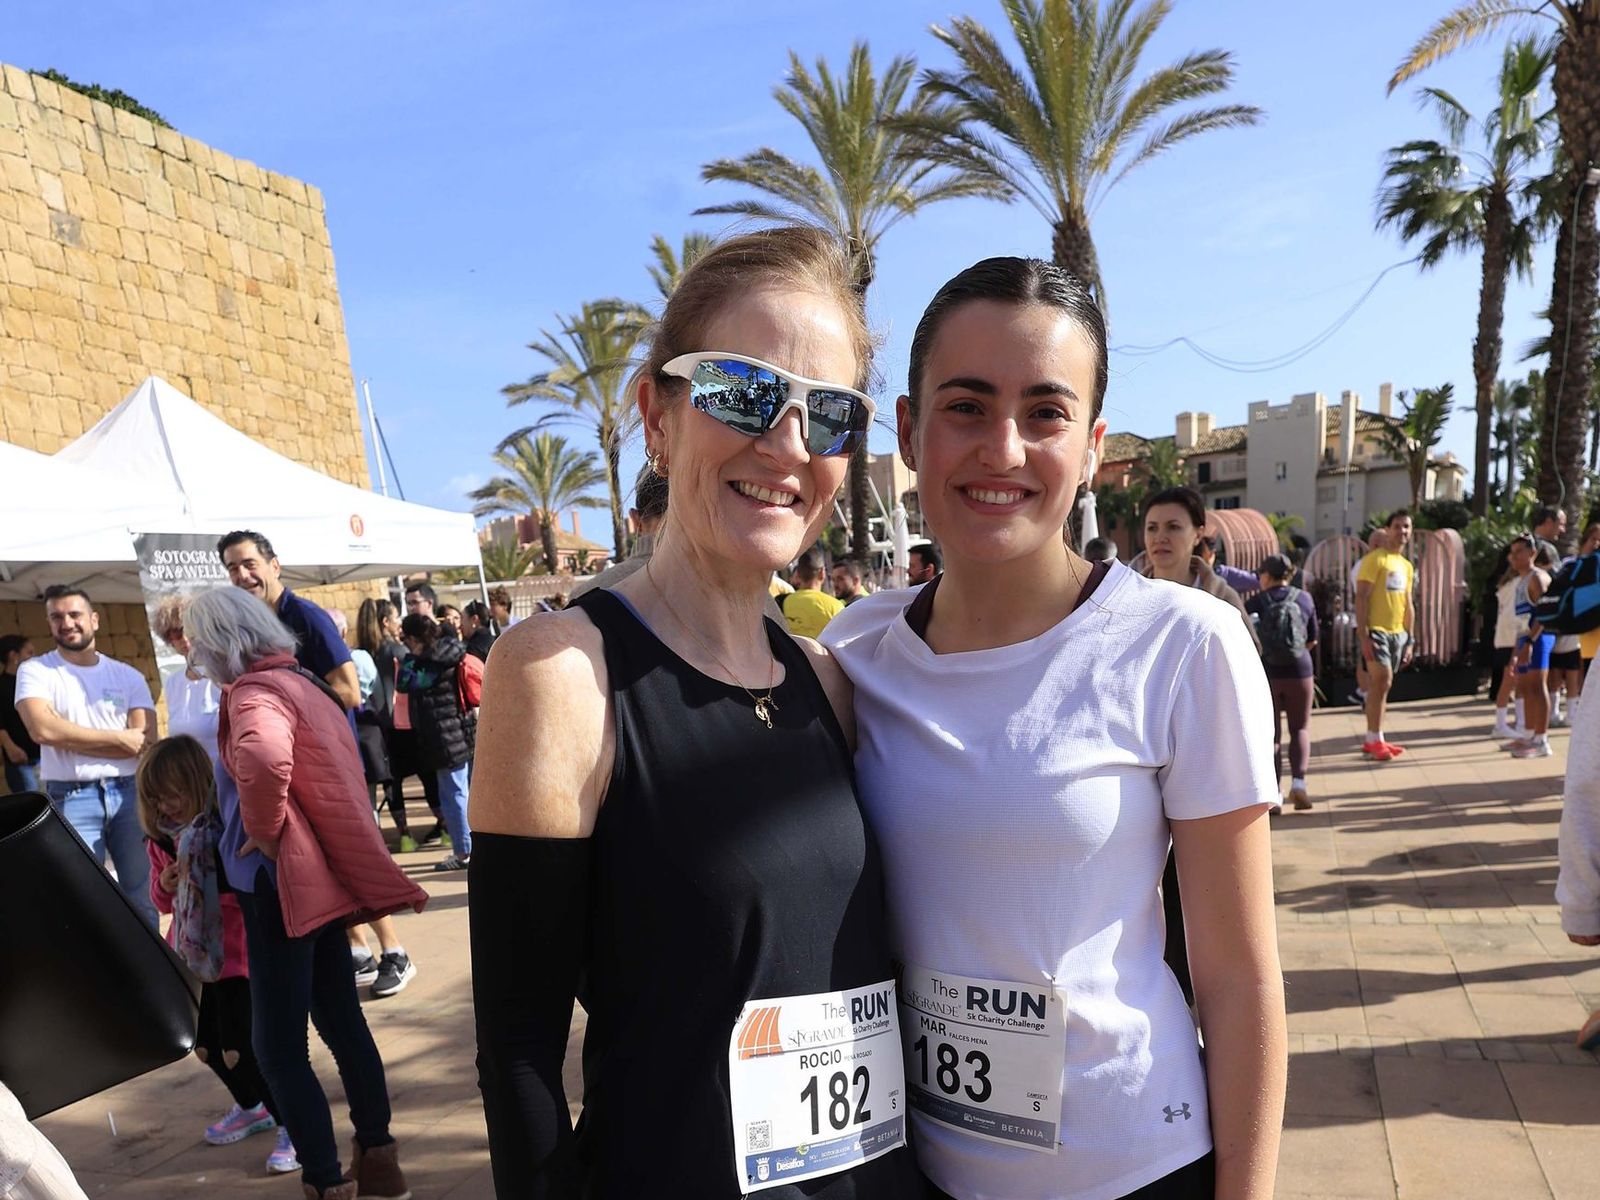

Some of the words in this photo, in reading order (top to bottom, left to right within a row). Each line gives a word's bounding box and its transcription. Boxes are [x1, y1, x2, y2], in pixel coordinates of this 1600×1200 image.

[821, 1003, 847, 1020] The
[851, 990, 889, 1024] RUN
[931, 978, 959, 998] The
[966, 985, 1046, 1020] RUN
[920, 1015, 947, 1036] MAR
[967, 1012, 976, 1021] 5k
[978, 1014, 1006, 1027] Charity
[1007, 1018, 1045, 1031] Challenge
[800, 1049, 842, 1070] ROCIO
[914, 1034, 992, 1103] 183
[800, 1065, 871, 1135] 182
[892, 1098, 897, 1110] S
[1033, 1101, 1041, 1112] S
[1001, 1123, 1044, 1139] BETANIA
